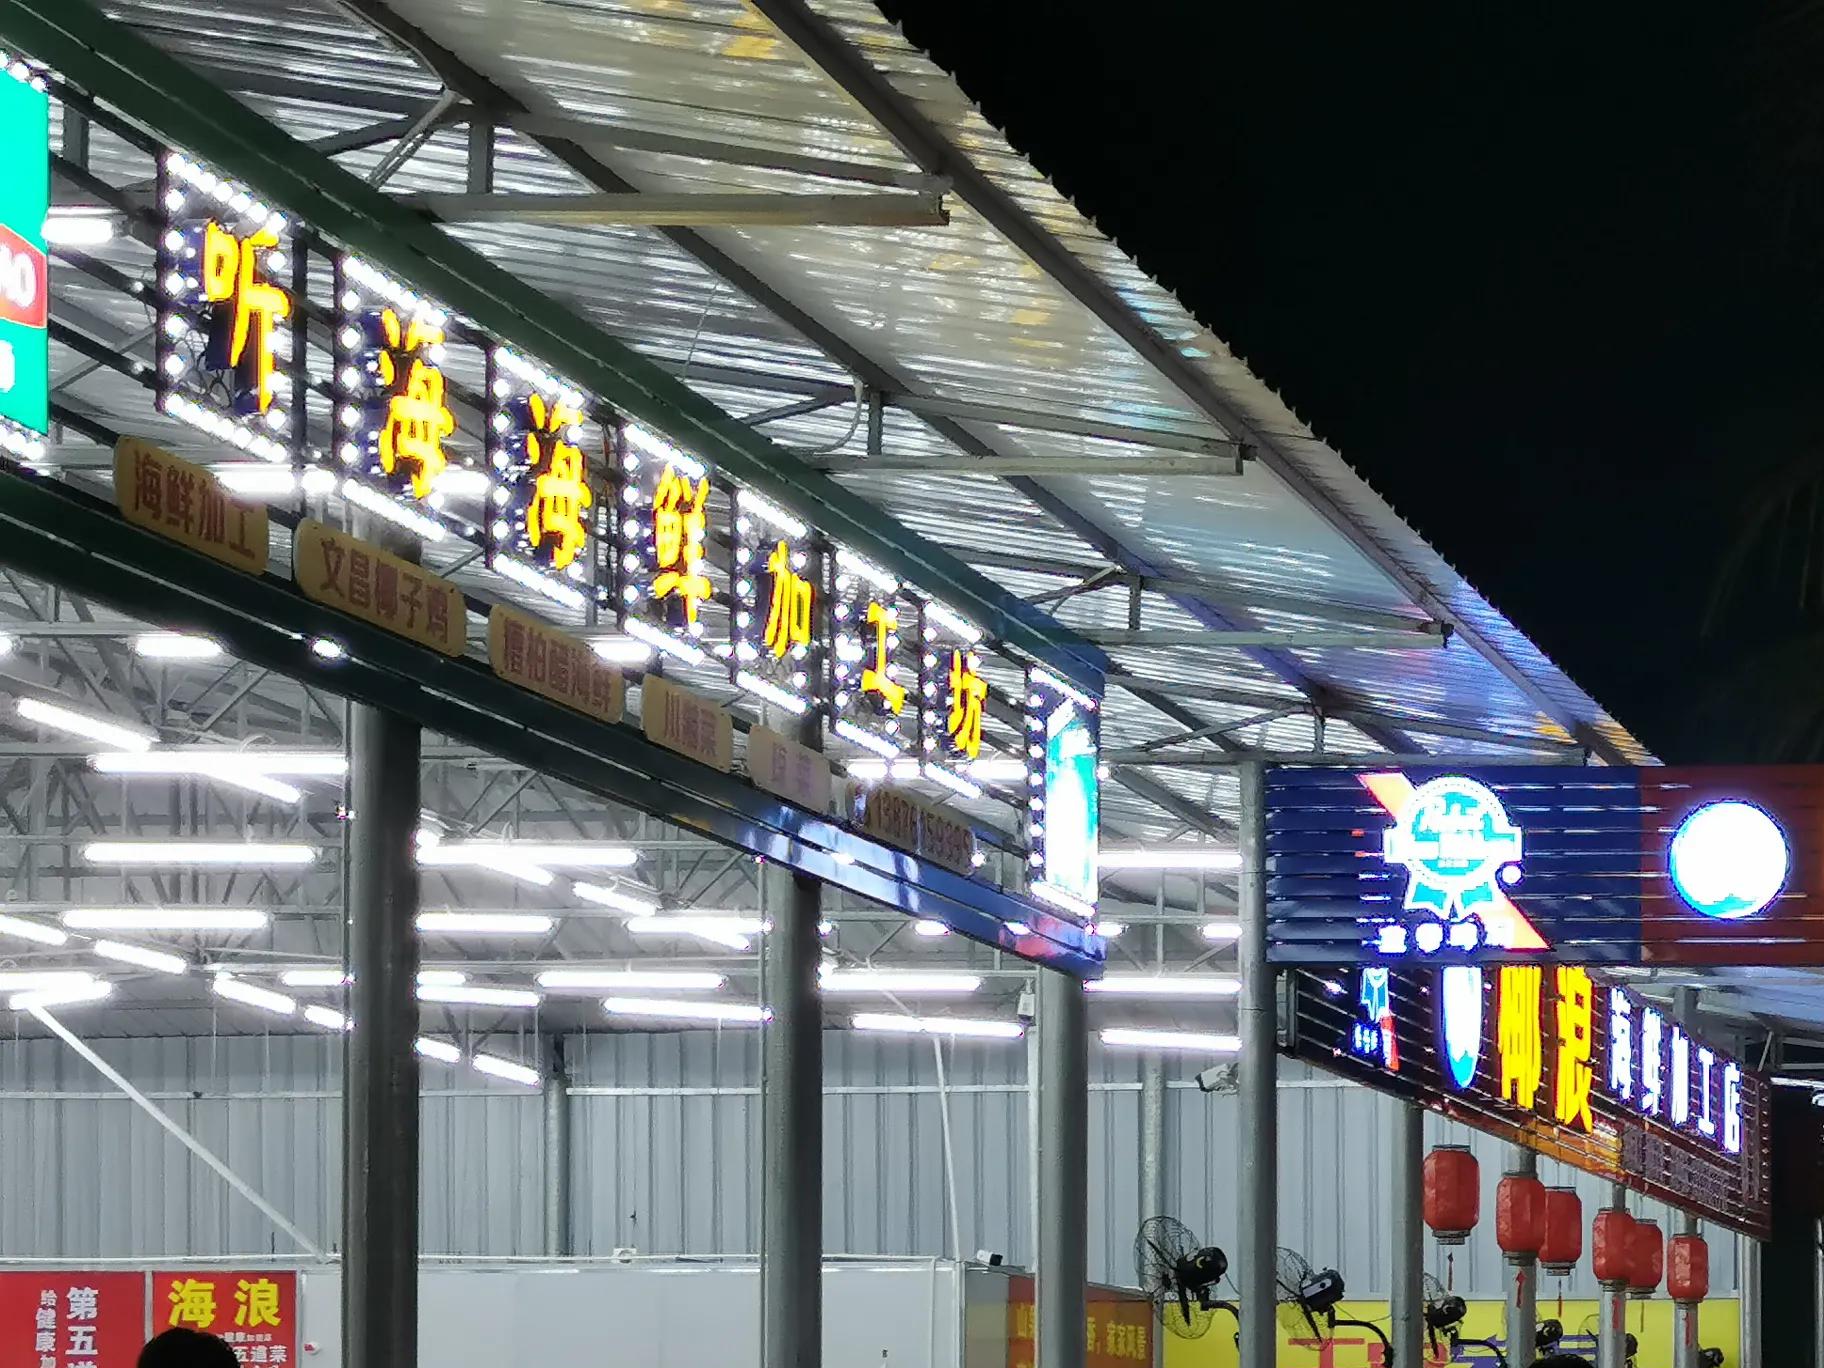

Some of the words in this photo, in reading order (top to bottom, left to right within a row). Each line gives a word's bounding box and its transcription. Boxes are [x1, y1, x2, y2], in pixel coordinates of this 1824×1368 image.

[133, 449, 256, 559] 海鲜加工
[202, 218, 989, 760] 听海海鲜加工坊
[1609, 985, 1742, 1154] 海鲜加工店
[167, 1278, 282, 1329] 海浪
[231, 1344, 288, 1363] 五道菜
